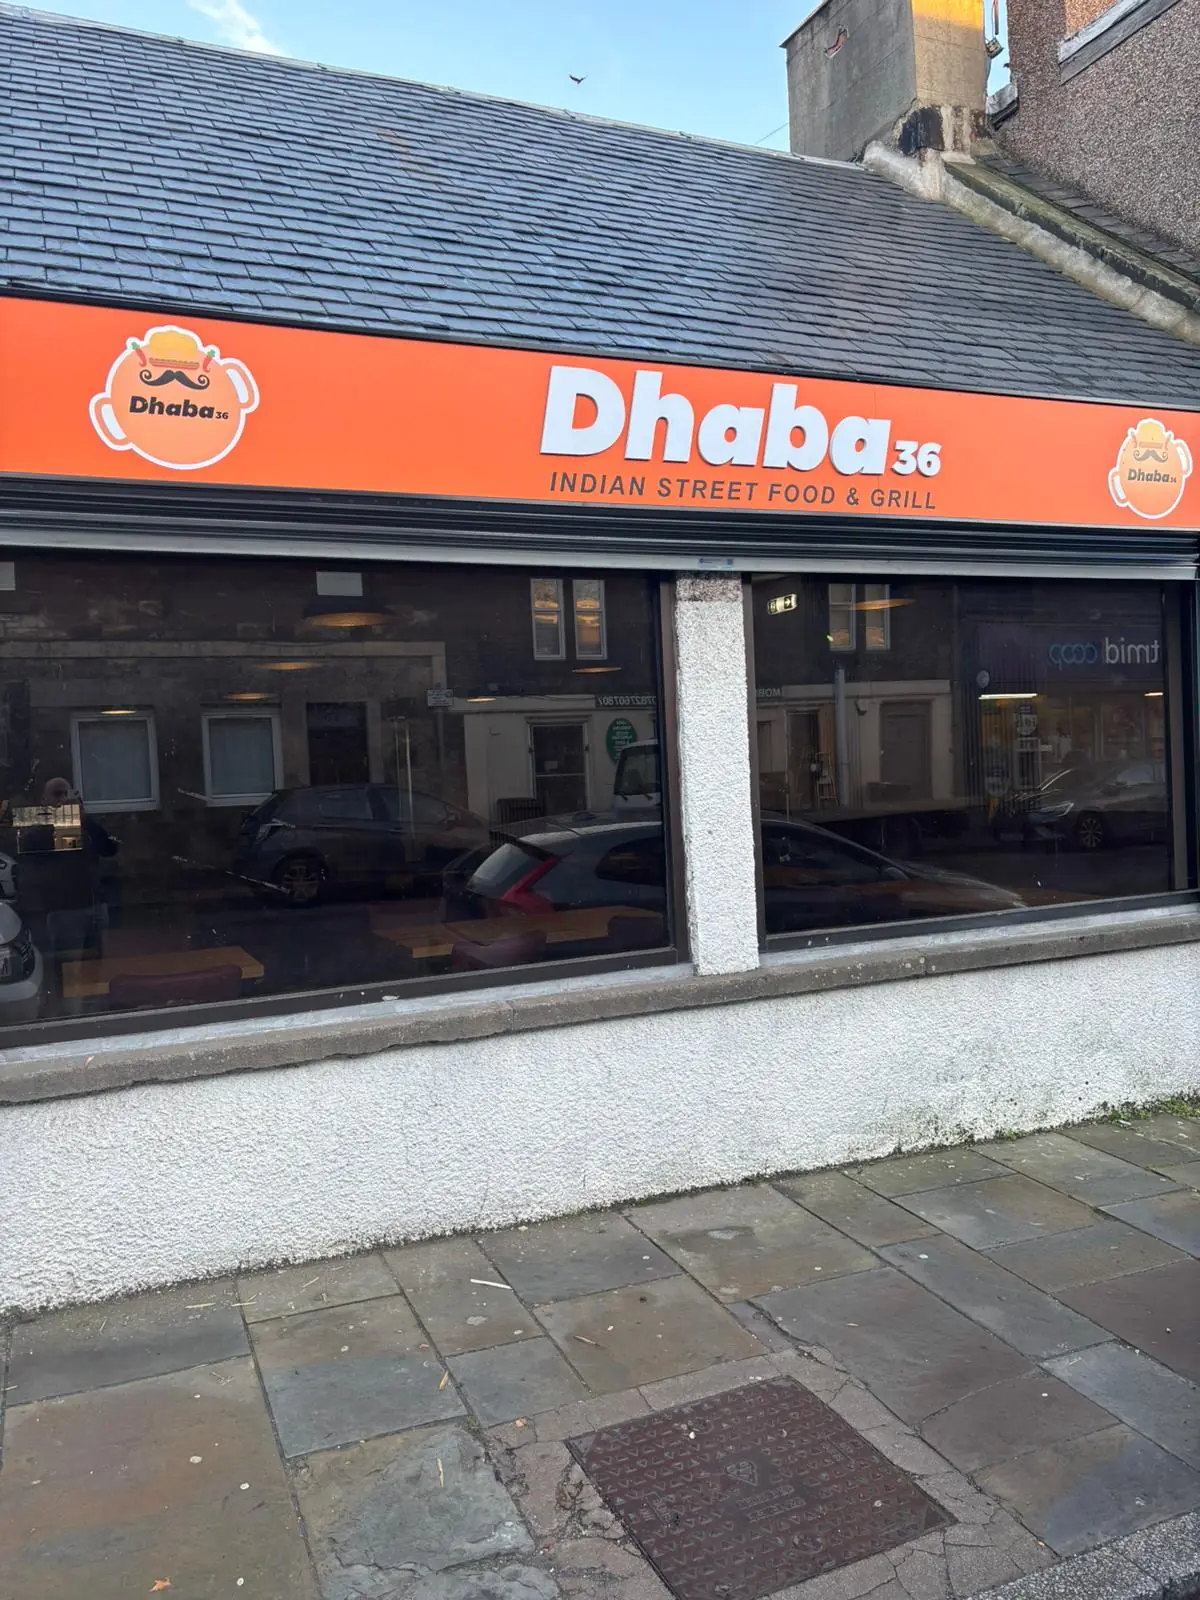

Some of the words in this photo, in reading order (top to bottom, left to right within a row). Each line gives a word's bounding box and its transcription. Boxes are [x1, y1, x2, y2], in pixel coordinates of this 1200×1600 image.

[129, 395, 214, 419] Dhaba
[215, 411, 229, 420] 36
[540, 366, 891, 476] Dhaba
[891, 440, 942, 478] 36
[549, 471, 646, 497] INDIAN
[657, 477, 759, 502] STREET
[768, 483, 836, 506] FOOD
[846, 488, 860, 506] &
[870, 489, 937, 510] GRILL
[1127, 468, 1170, 483] Dhaba
